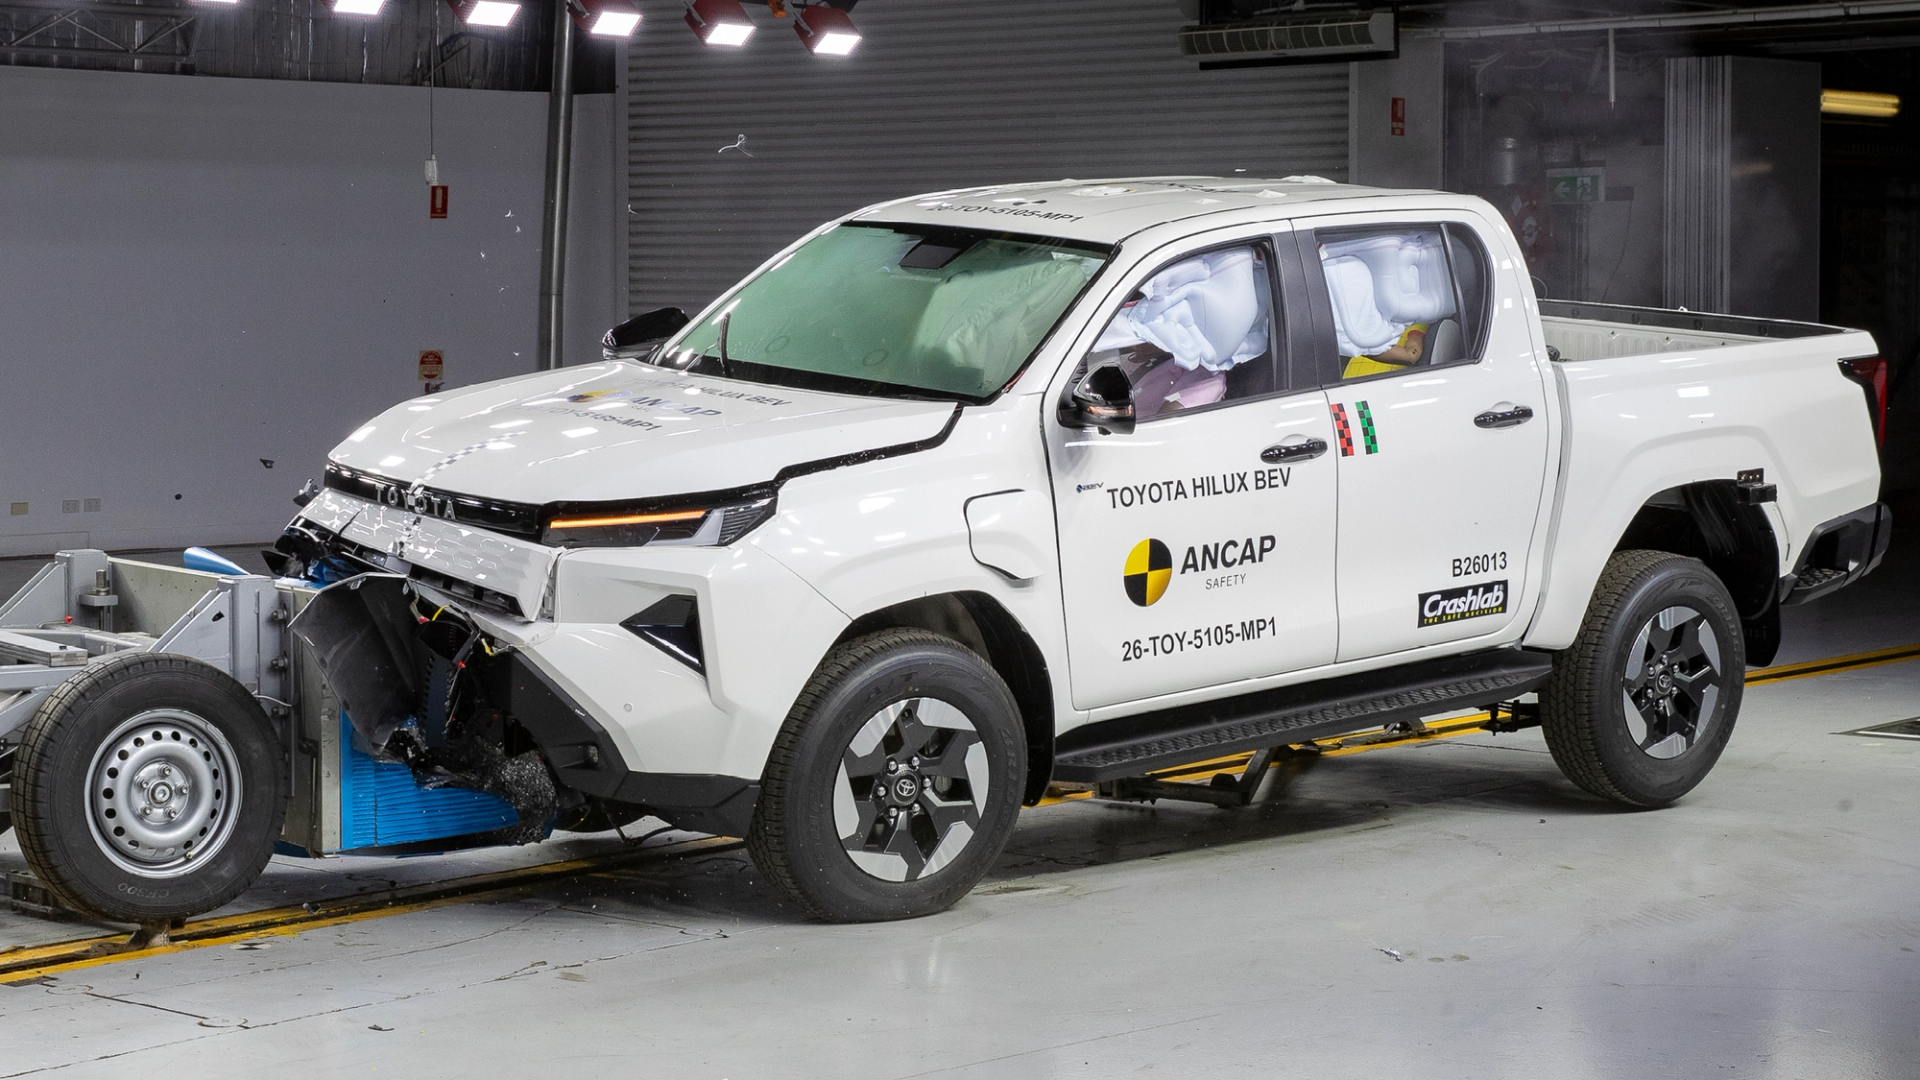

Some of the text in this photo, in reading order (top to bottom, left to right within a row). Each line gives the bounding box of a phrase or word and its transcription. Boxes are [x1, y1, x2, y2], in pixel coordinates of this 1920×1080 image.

[747, 394, 793, 407] BEV
[375, 484, 457, 520] TOYOTA
[1107, 467, 1291, 509] TOYOTA HILUX BEV
[1180, 535, 1276, 575] ANCAP
[1452, 551, 1507, 577] B26013
[1205, 573, 1247, 590] SAFETY
[1424, 584, 1504, 618] Crashlab
[1443, 614, 1461, 622] SAFE
[1465, 606, 1502, 617] DECISION
[1122, 616, 1276, 662] 26-TOY-5105-MP1
